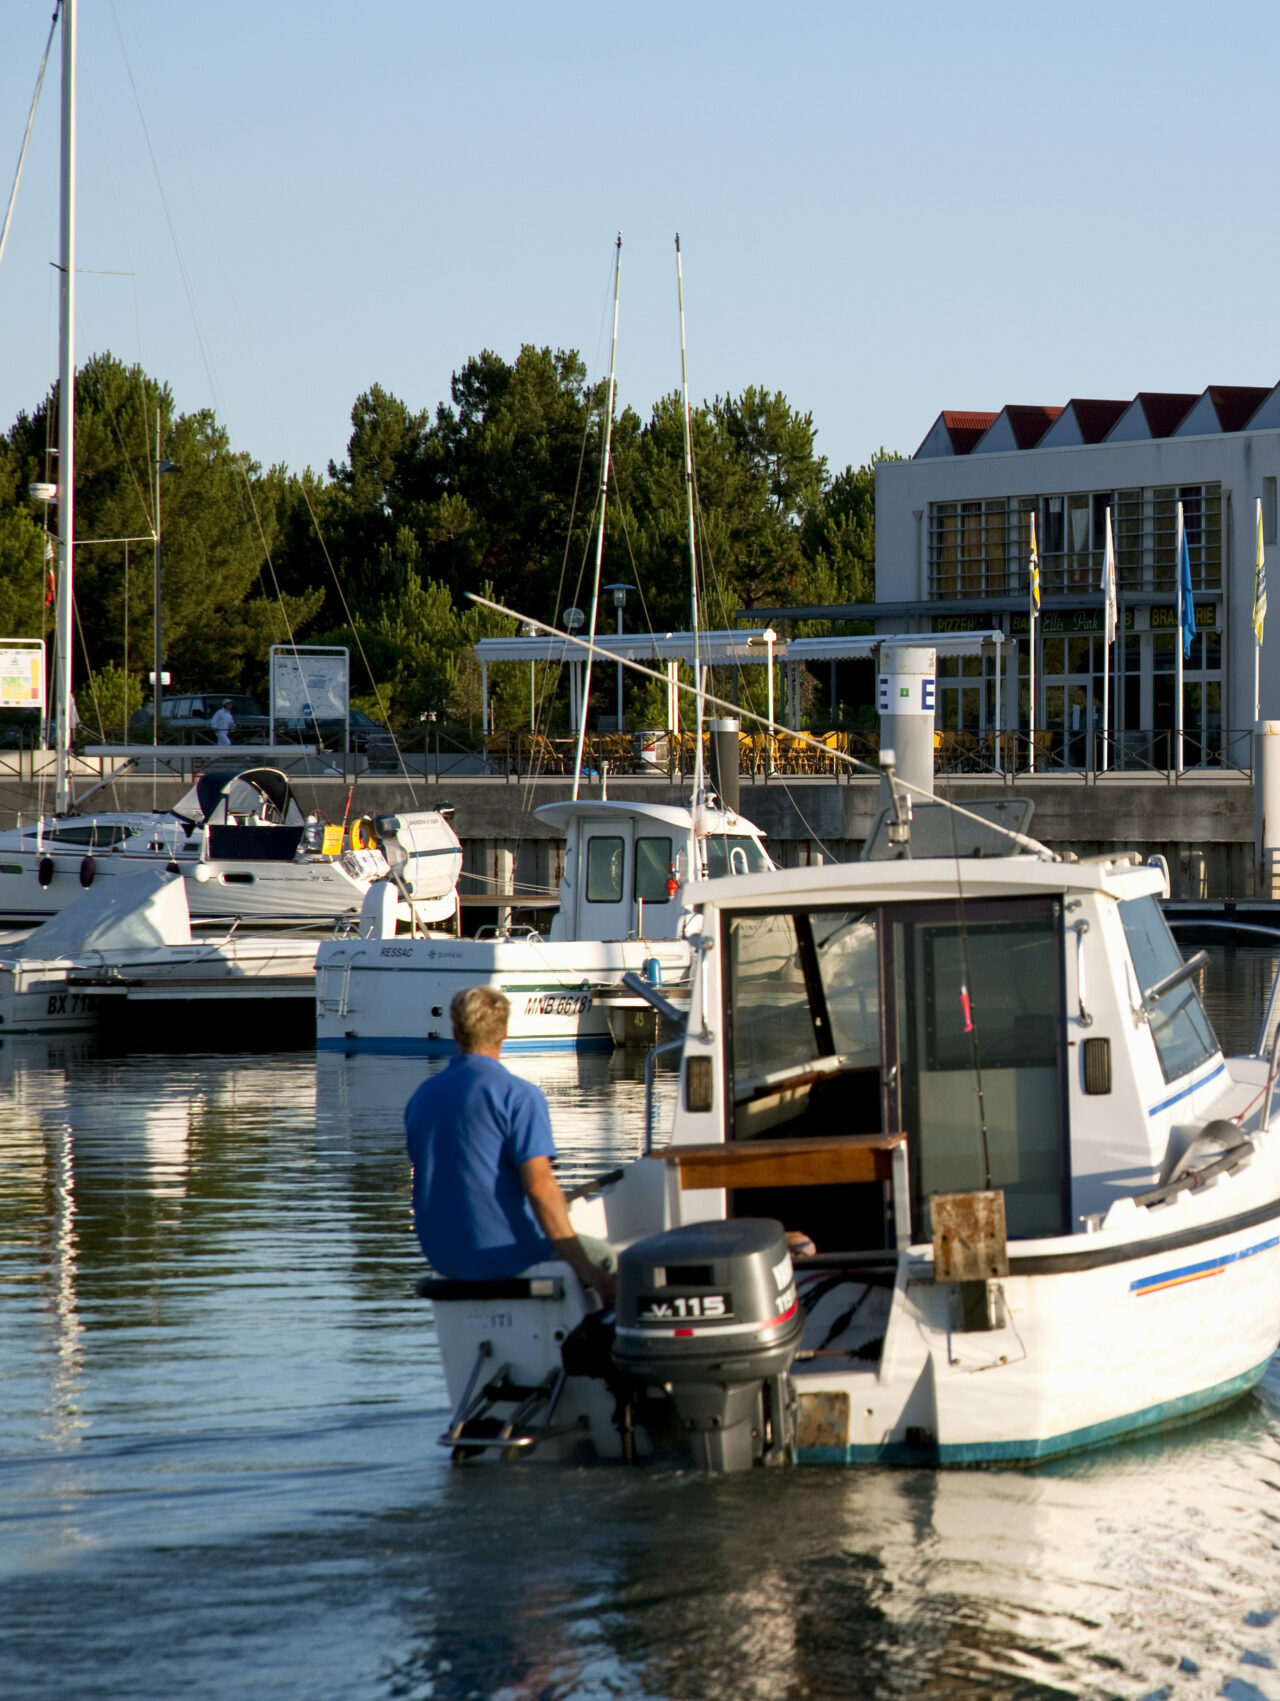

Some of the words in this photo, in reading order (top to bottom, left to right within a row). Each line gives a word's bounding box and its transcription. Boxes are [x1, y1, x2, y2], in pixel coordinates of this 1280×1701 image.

[1042, 610, 1064, 632] Ellis
[1073, 608, 1098, 631] Park
[1151, 606, 1214, 626] BRARIE
[921, 679, 934, 710] E
[380, 947, 413, 958] RESSAC
[47, 994, 67, 1015] BX
[524, 996, 555, 1015] MNB
[556, 995, 592, 1015] 66181
[634, 1011, 645, 1027] 45
[674, 1296, 725, 1316] 115
